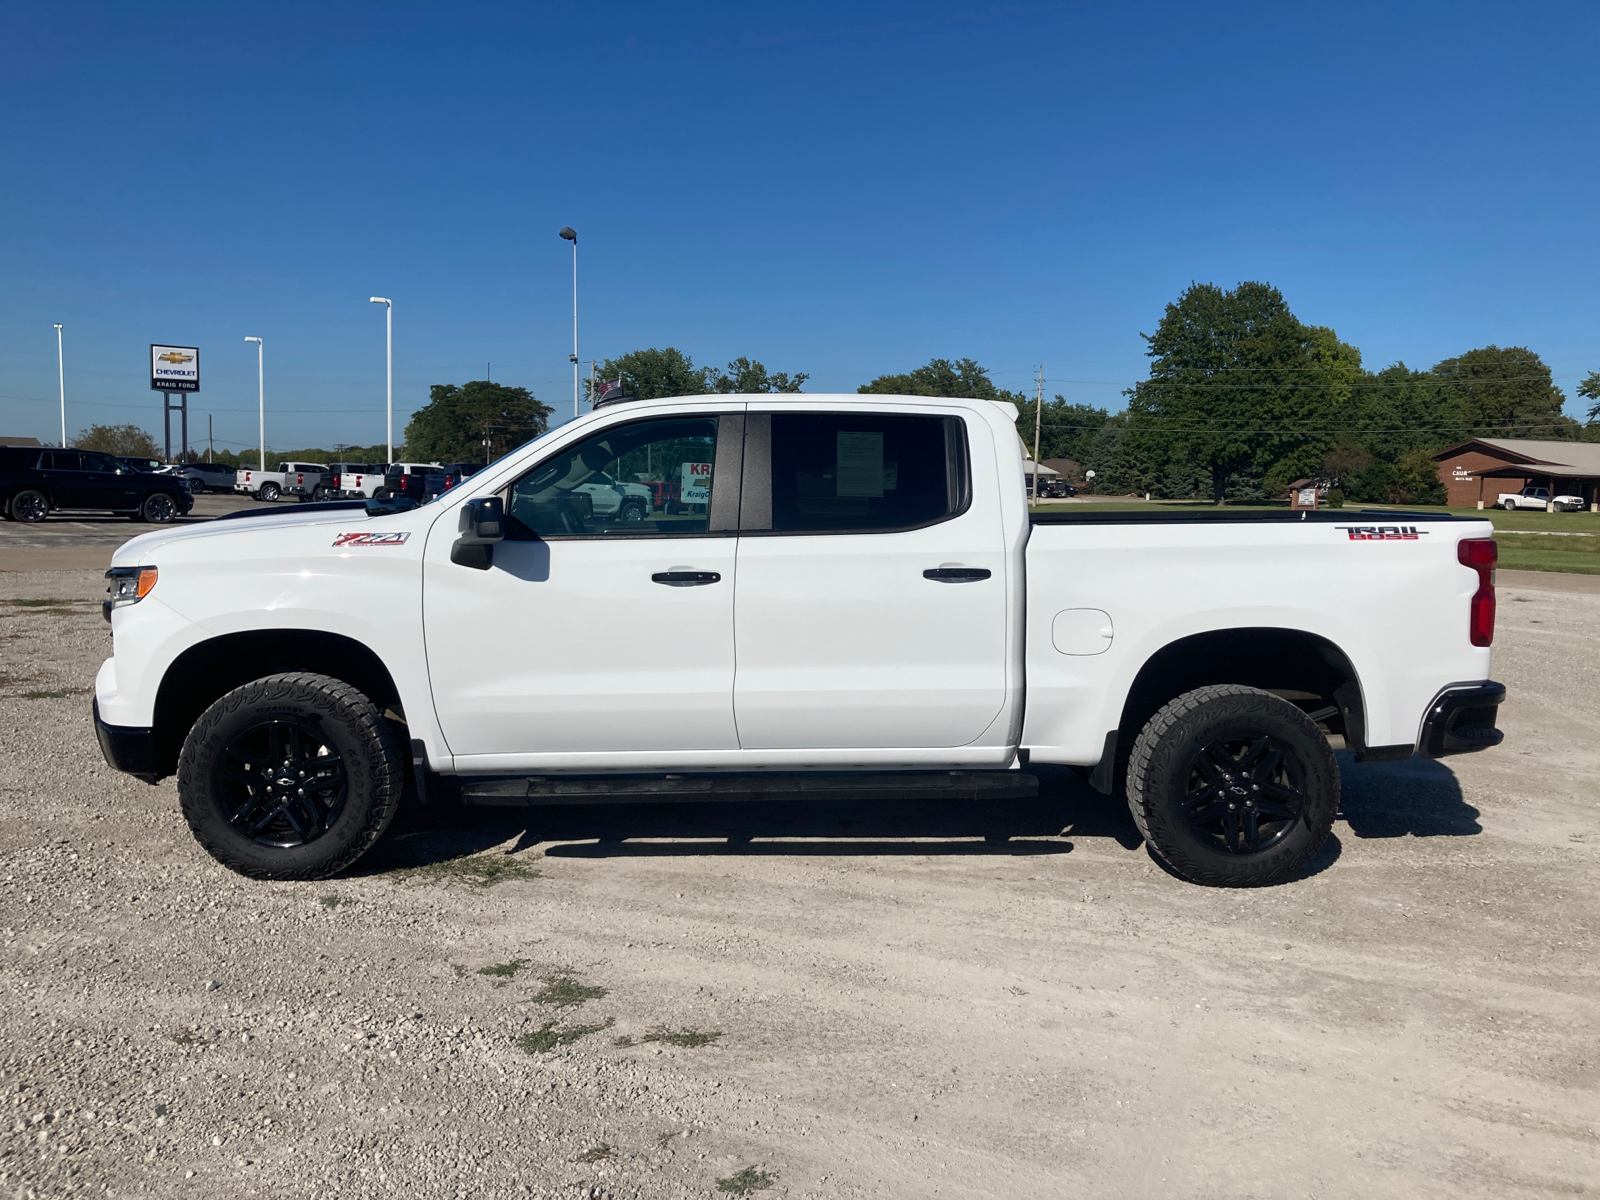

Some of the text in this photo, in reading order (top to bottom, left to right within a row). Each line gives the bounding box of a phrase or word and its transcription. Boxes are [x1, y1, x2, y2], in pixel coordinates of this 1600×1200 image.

[691, 464, 711, 475] KR
[687, 491, 710, 499] KraigC
[331, 532, 411, 547] Z71
